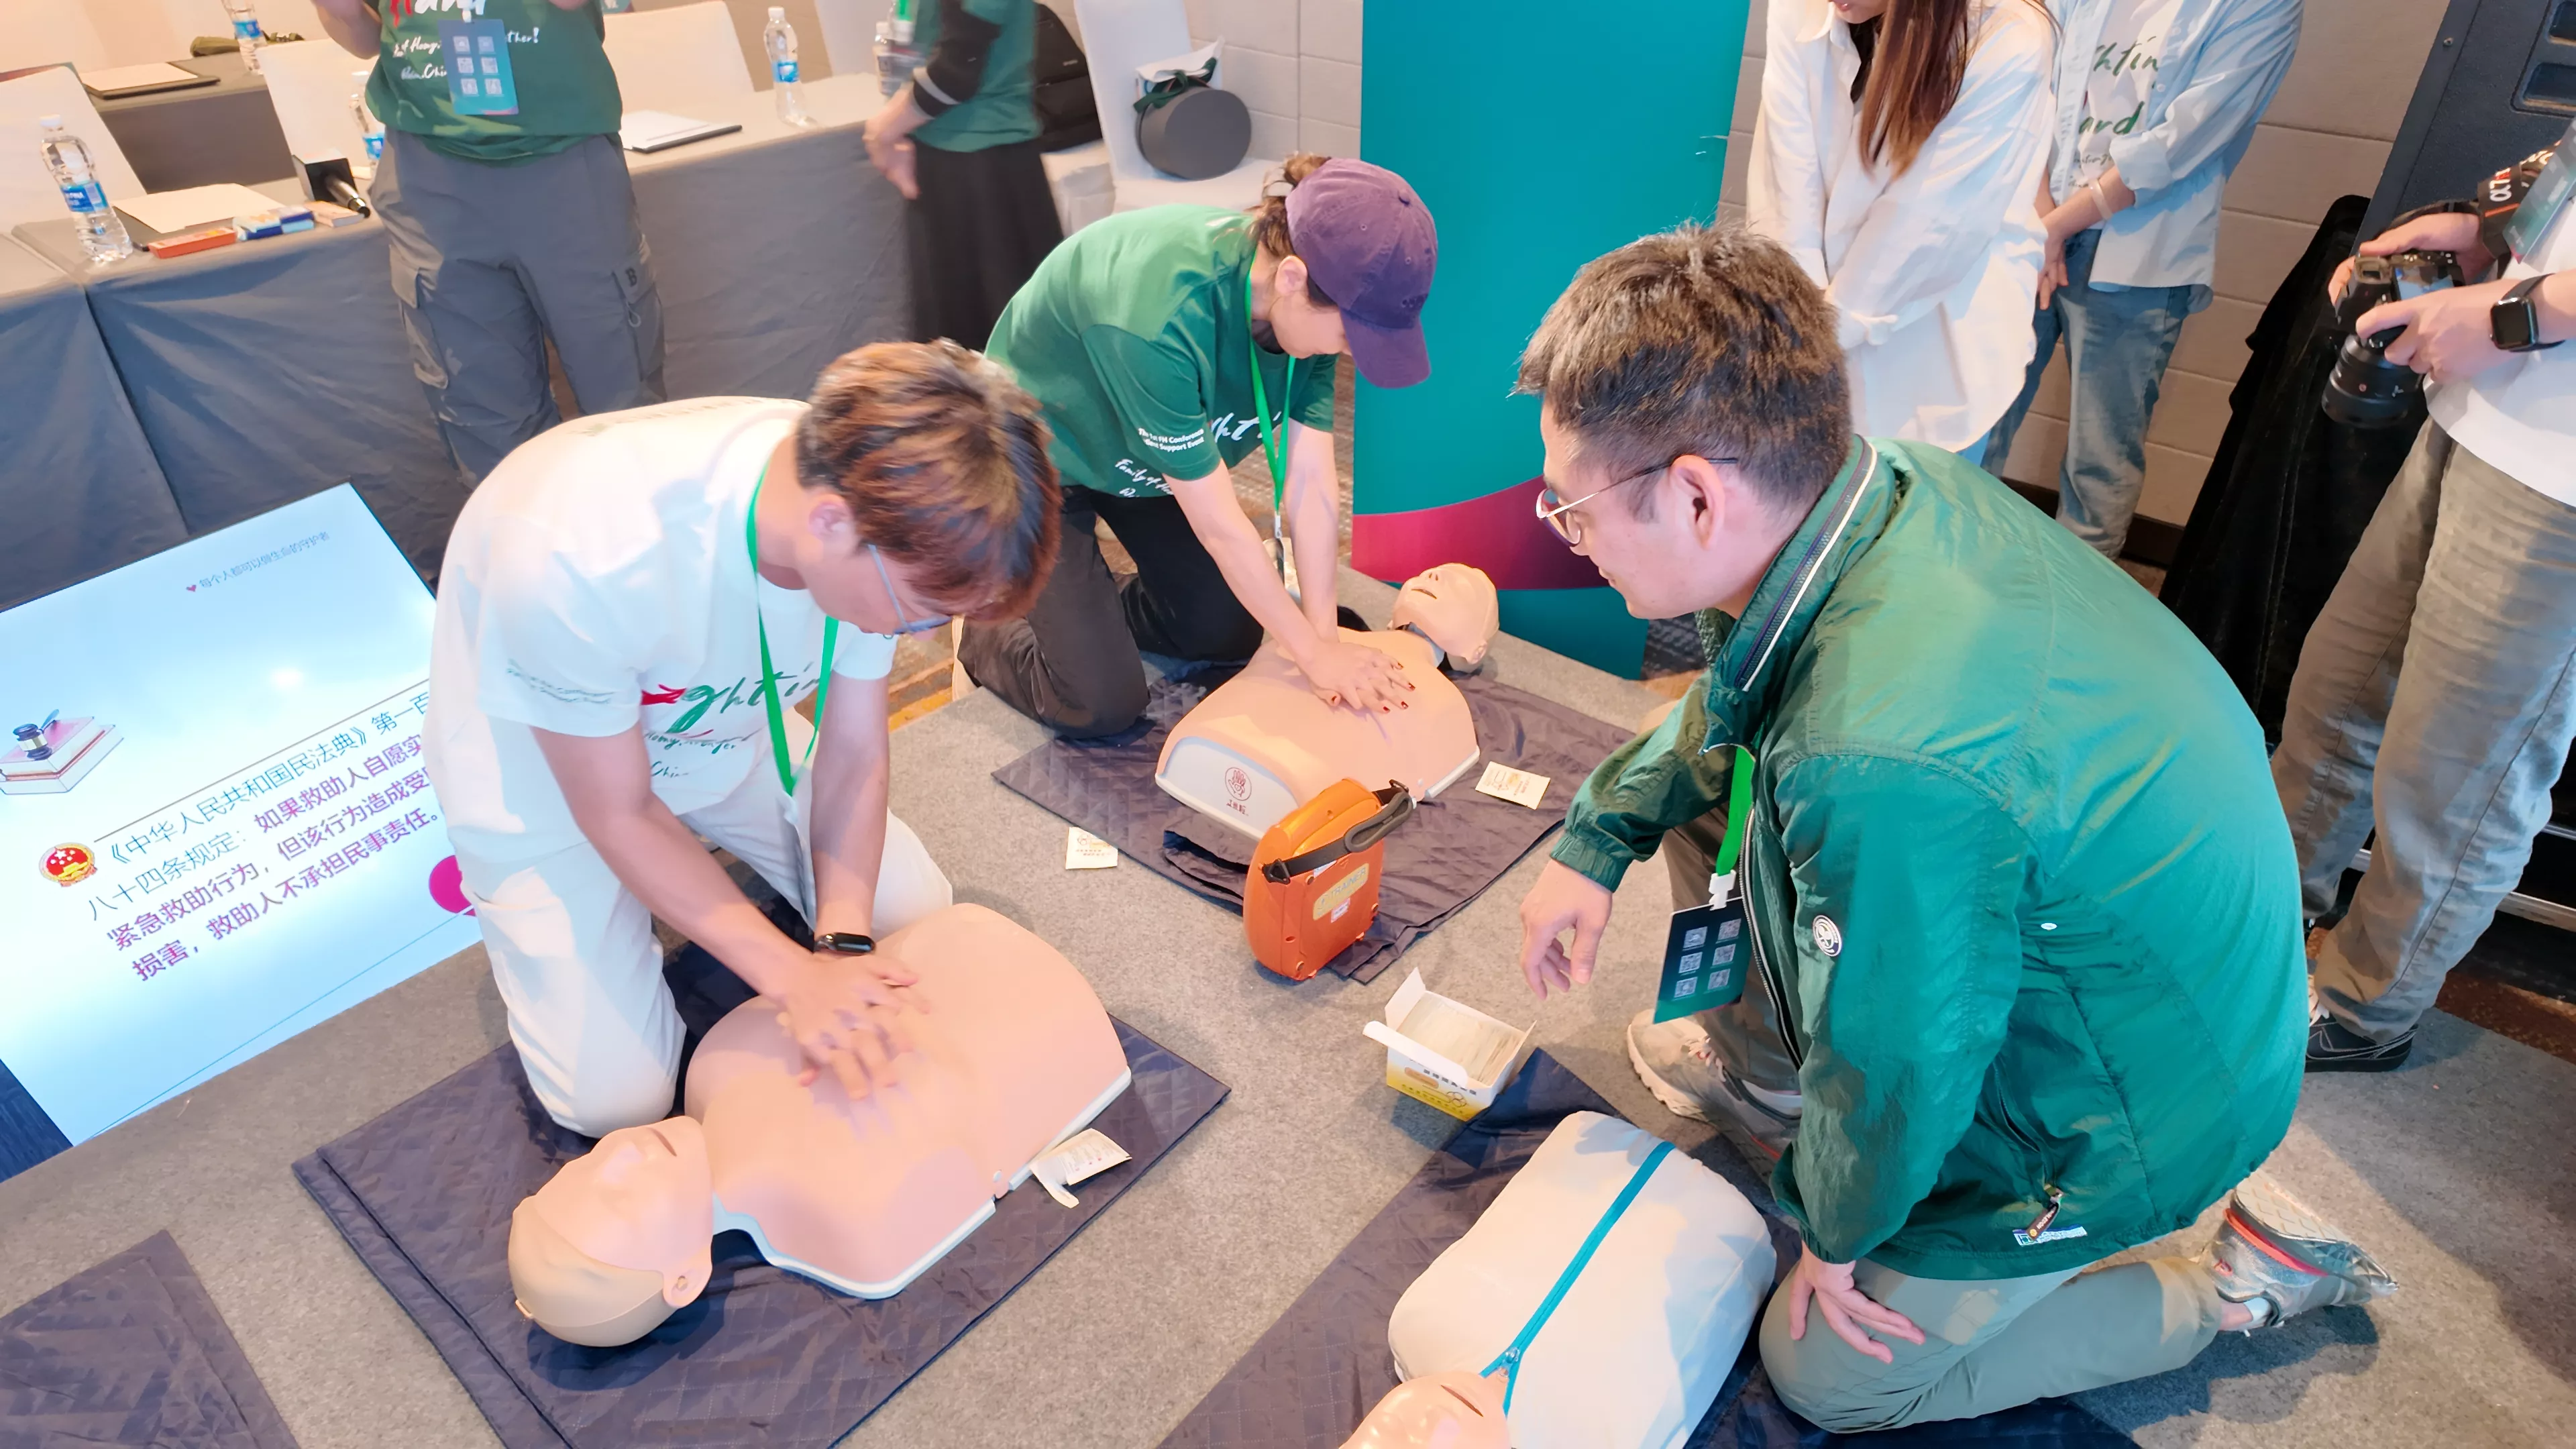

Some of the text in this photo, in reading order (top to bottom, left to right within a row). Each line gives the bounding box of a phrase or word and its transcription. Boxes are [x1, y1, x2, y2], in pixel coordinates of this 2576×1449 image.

[1159, 443, 1187, 453] Support
[1114, 458, 1148, 482] Family
[107, 767, 431, 951] 紧急救助行为，但该行为造成受
